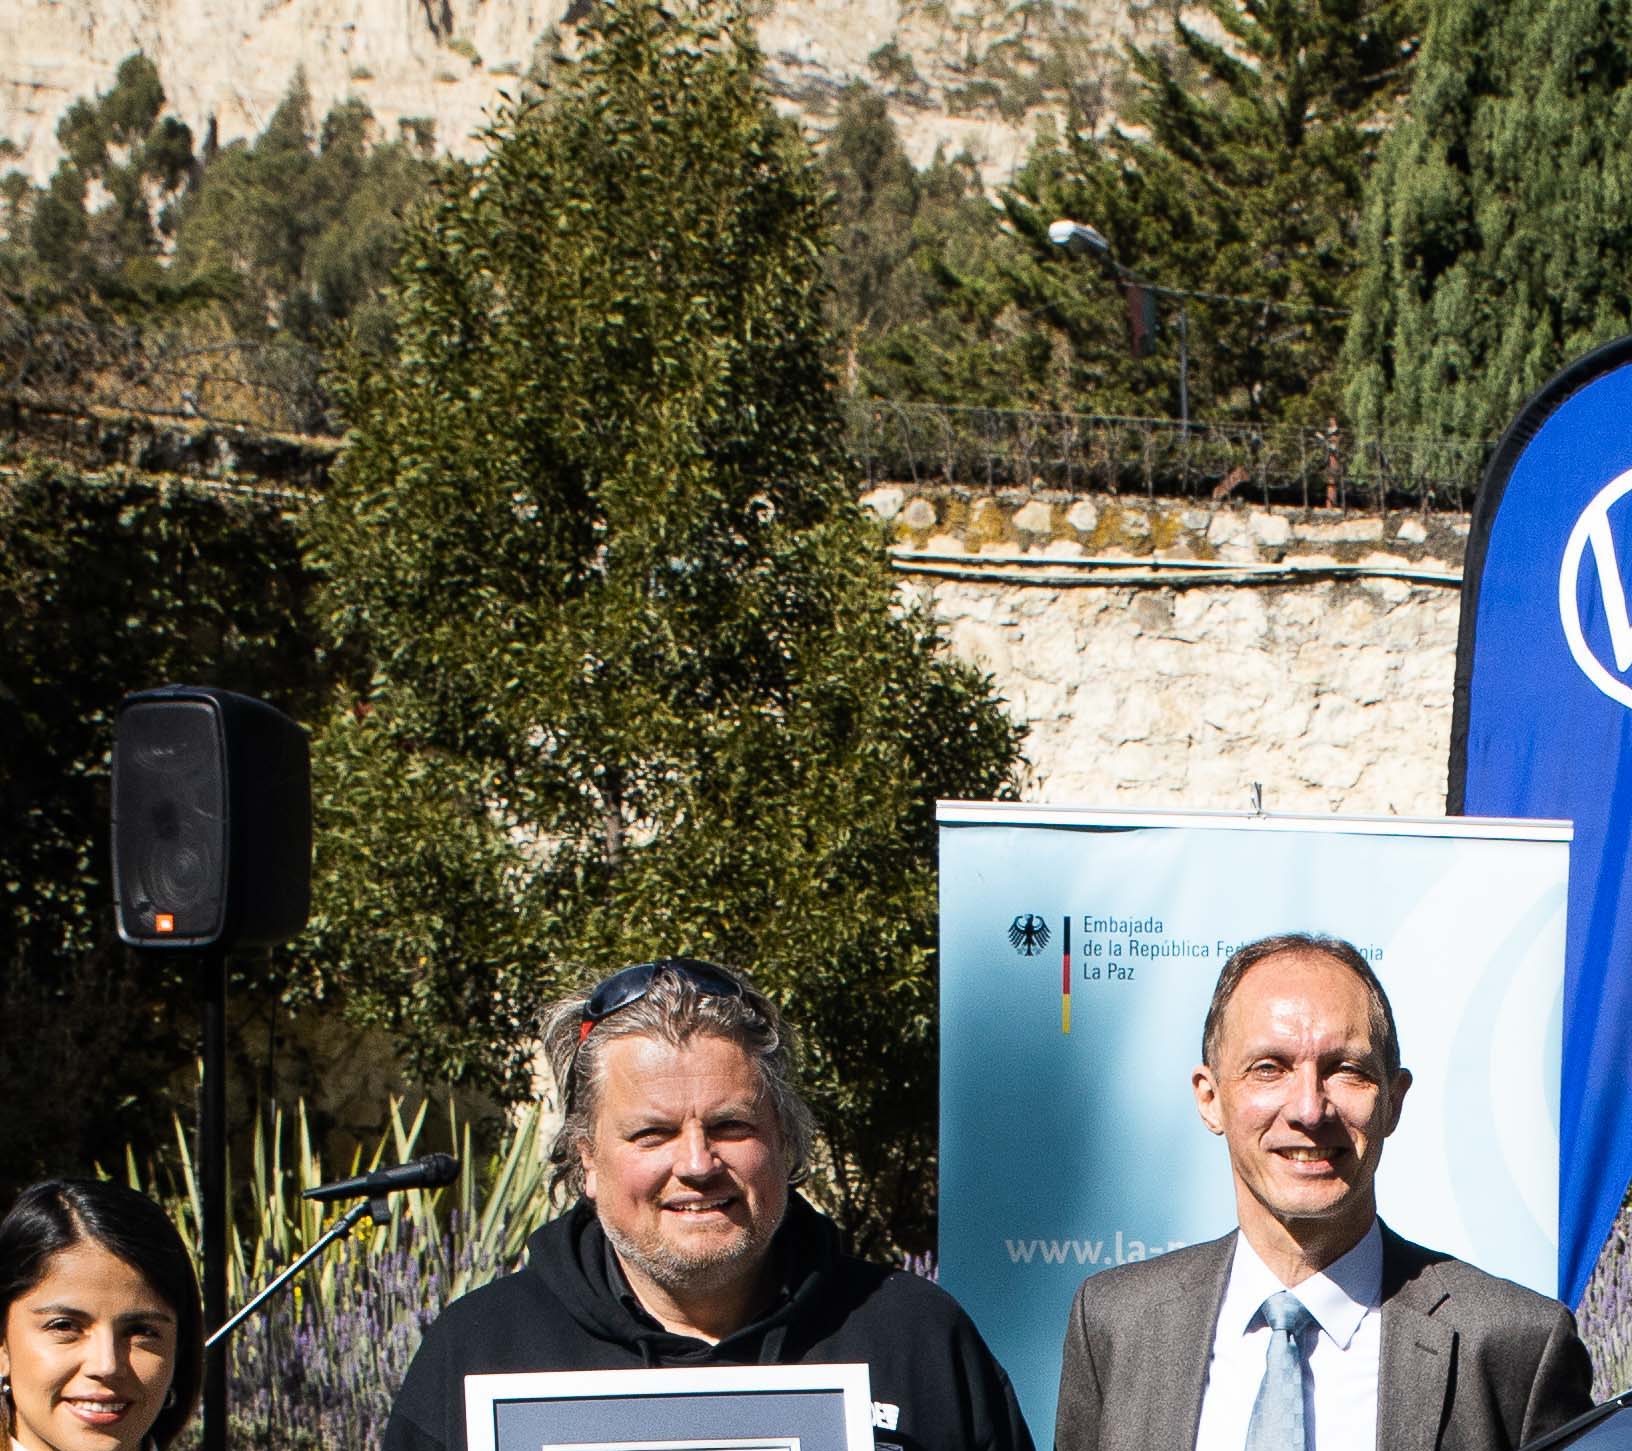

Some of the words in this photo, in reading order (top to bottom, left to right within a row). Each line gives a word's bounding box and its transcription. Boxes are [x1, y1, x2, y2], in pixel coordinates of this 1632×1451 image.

[1084, 916, 1163, 936] Embajada
[1083, 941, 1102, 957] de
[1109, 940, 1122, 957] la
[1130, 940, 1209, 960] República
[1084, 963, 1100, 980] La
[1108, 964, 1135, 980] Paz
